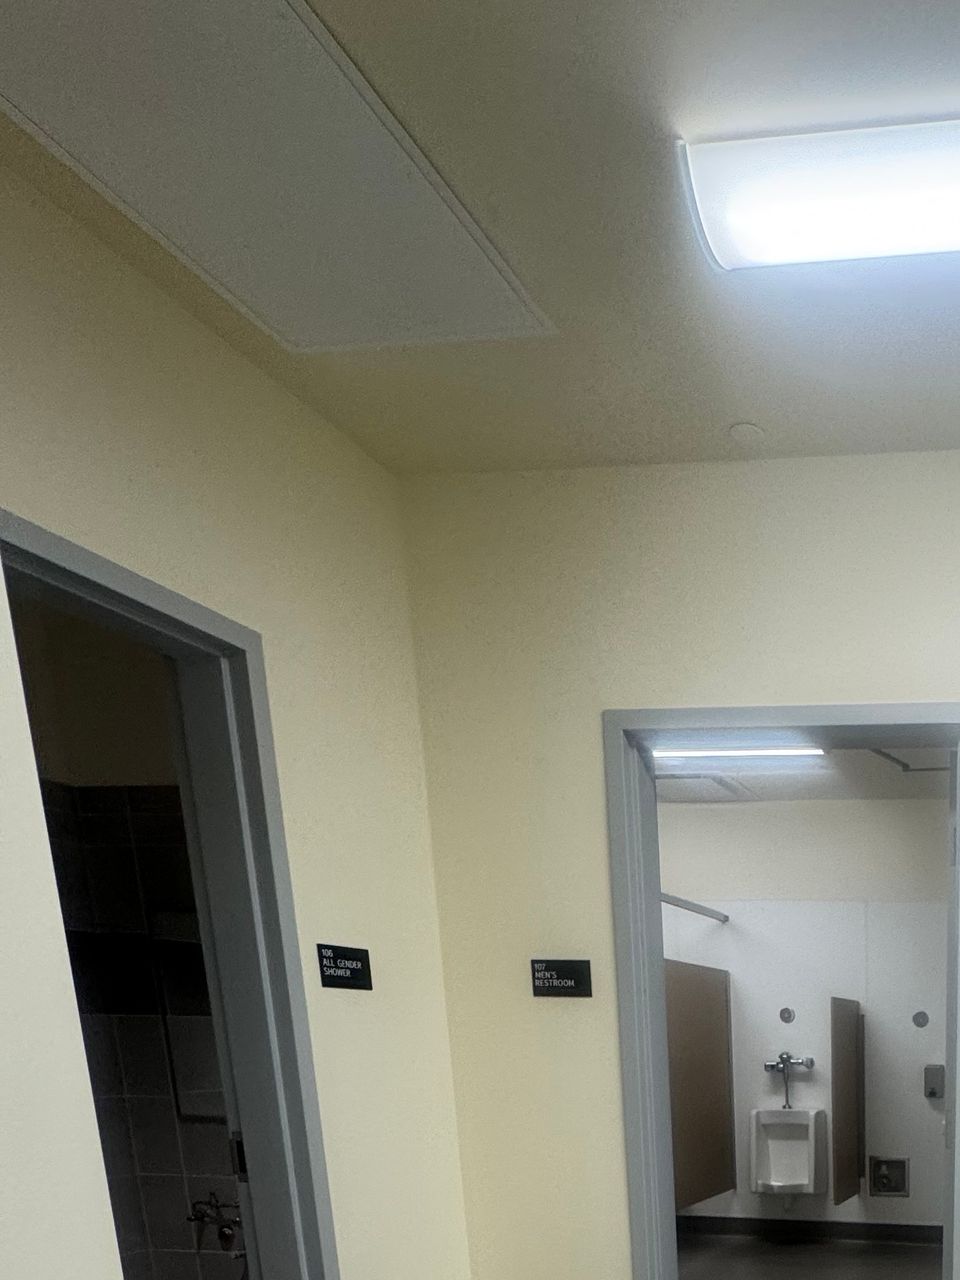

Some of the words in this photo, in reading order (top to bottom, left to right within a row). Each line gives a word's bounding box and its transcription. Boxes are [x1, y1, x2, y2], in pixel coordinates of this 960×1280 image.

[322, 958, 335, 967] ALL
[337, 959, 362, 969] GENDER
[534, 963, 546, 972] 107
[323, 967, 352, 977] SHOWER
[534, 971, 557, 979] MEN'S
[534, 979, 575, 987] RESTROOM
